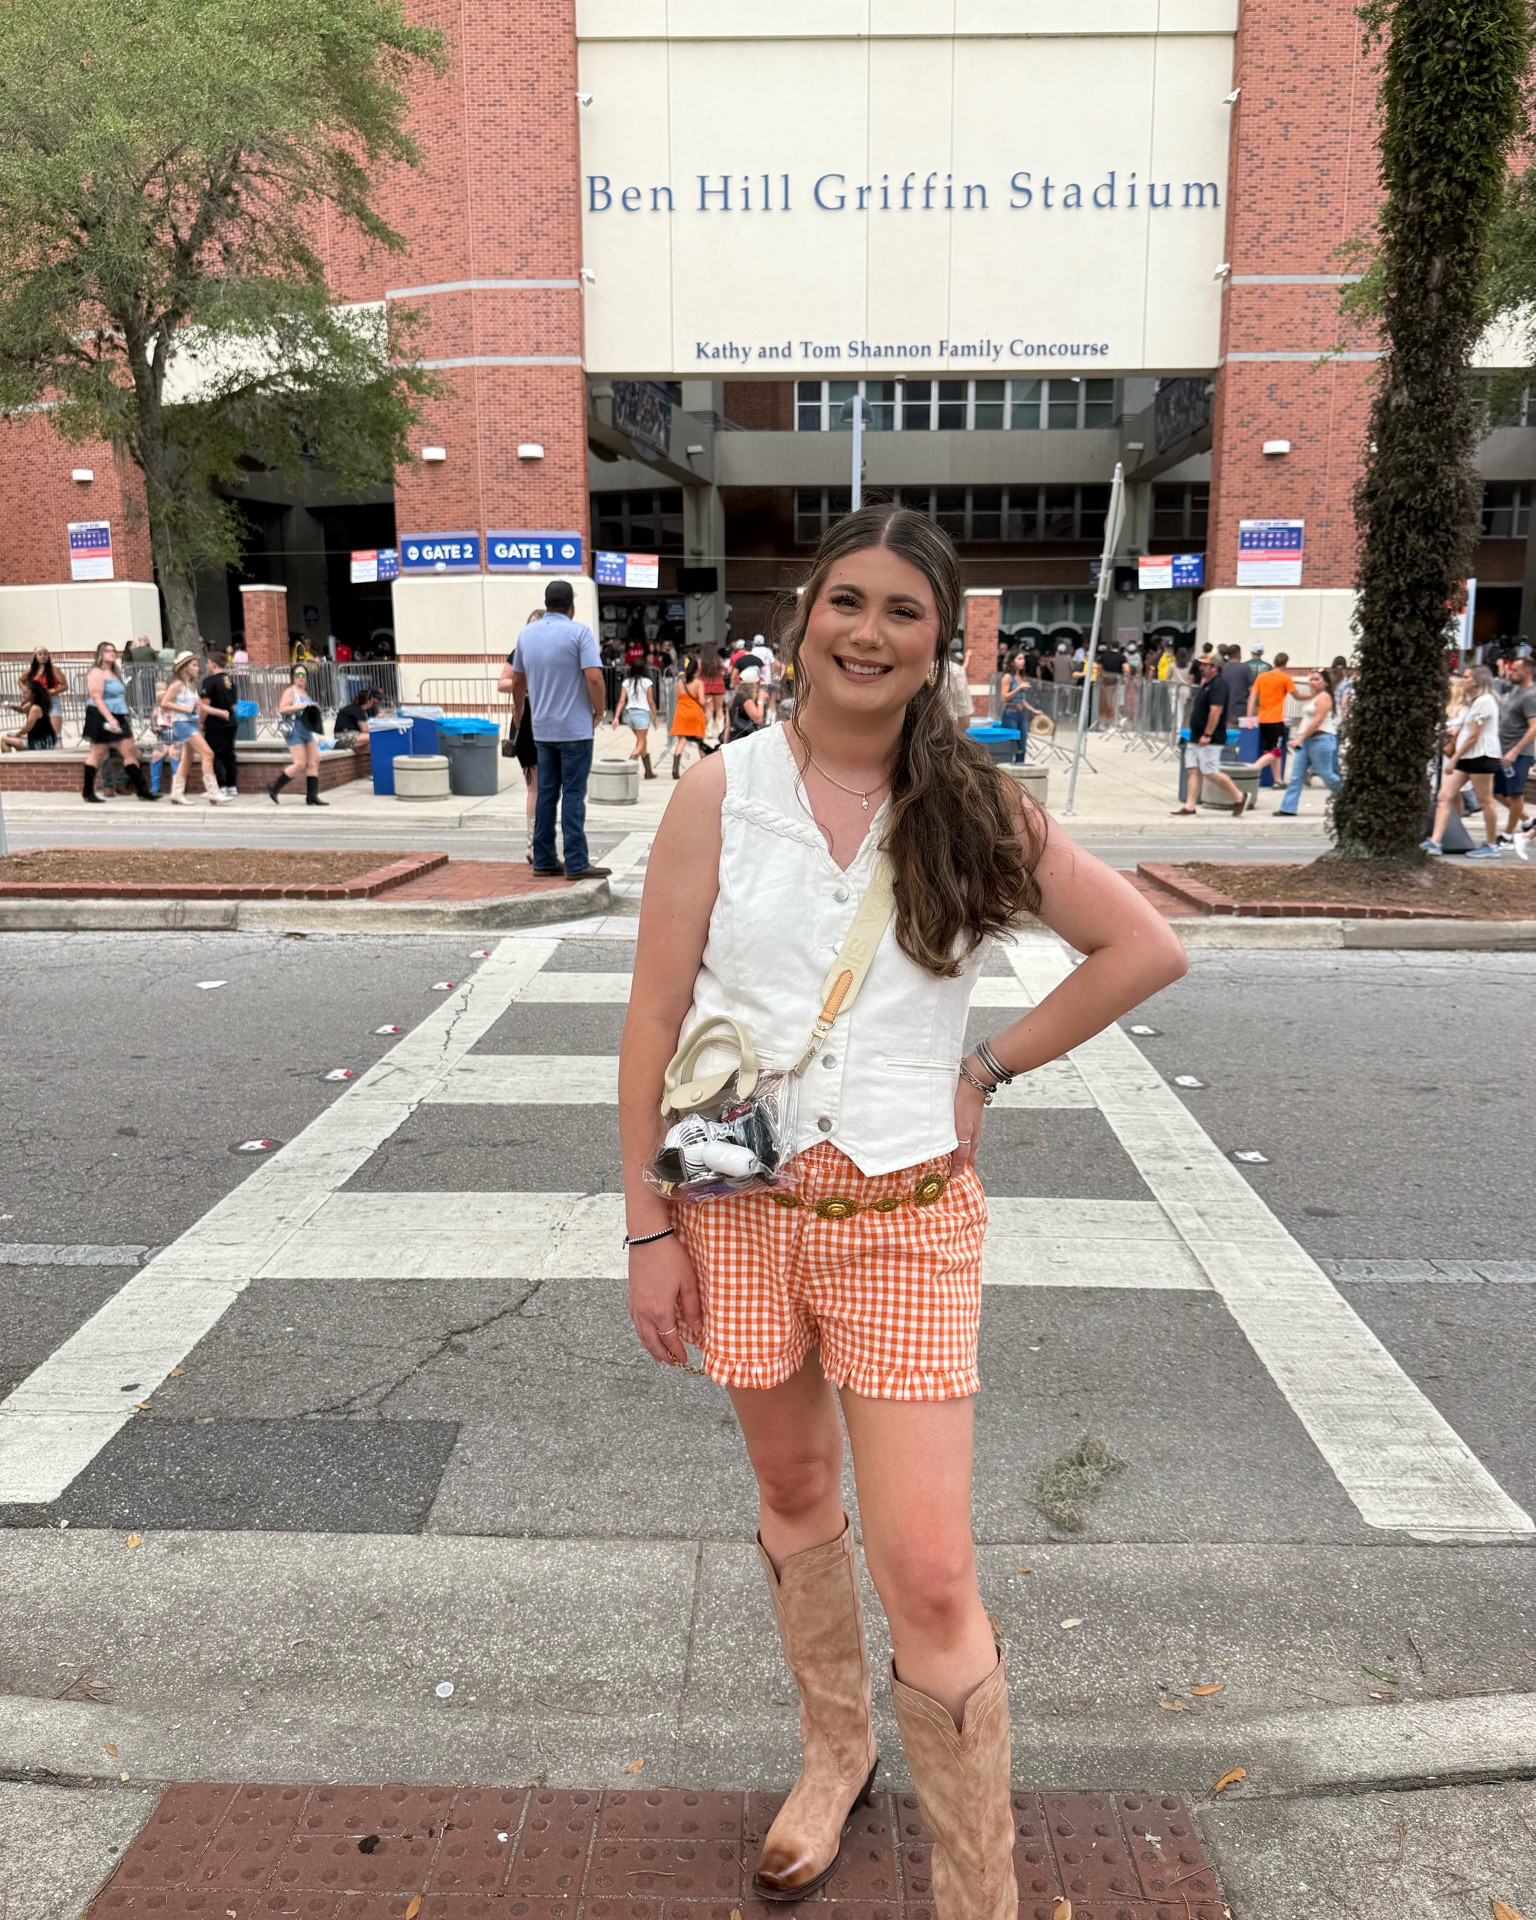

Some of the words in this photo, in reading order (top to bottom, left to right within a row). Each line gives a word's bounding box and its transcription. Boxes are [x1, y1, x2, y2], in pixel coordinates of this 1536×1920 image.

[587, 175, 675, 213] Ben
[697, 173, 793, 213] Hill
[812, 171, 989, 212] Griffin
[1008, 170, 1221, 210] Stadium
[695, 340, 752, 362] Kathy
[757, 341, 793, 359] and
[799, 340, 842, 359] Tom
[847, 340, 932, 359] Shannon
[937, 340, 1004, 362] Family
[1008, 339, 1110, 358] Concourse
[422, 544, 461, 560] GATE
[463, 543, 474, 559] 2
[494, 542, 542, 559] GATE
[545, 543, 554, 559] 1
